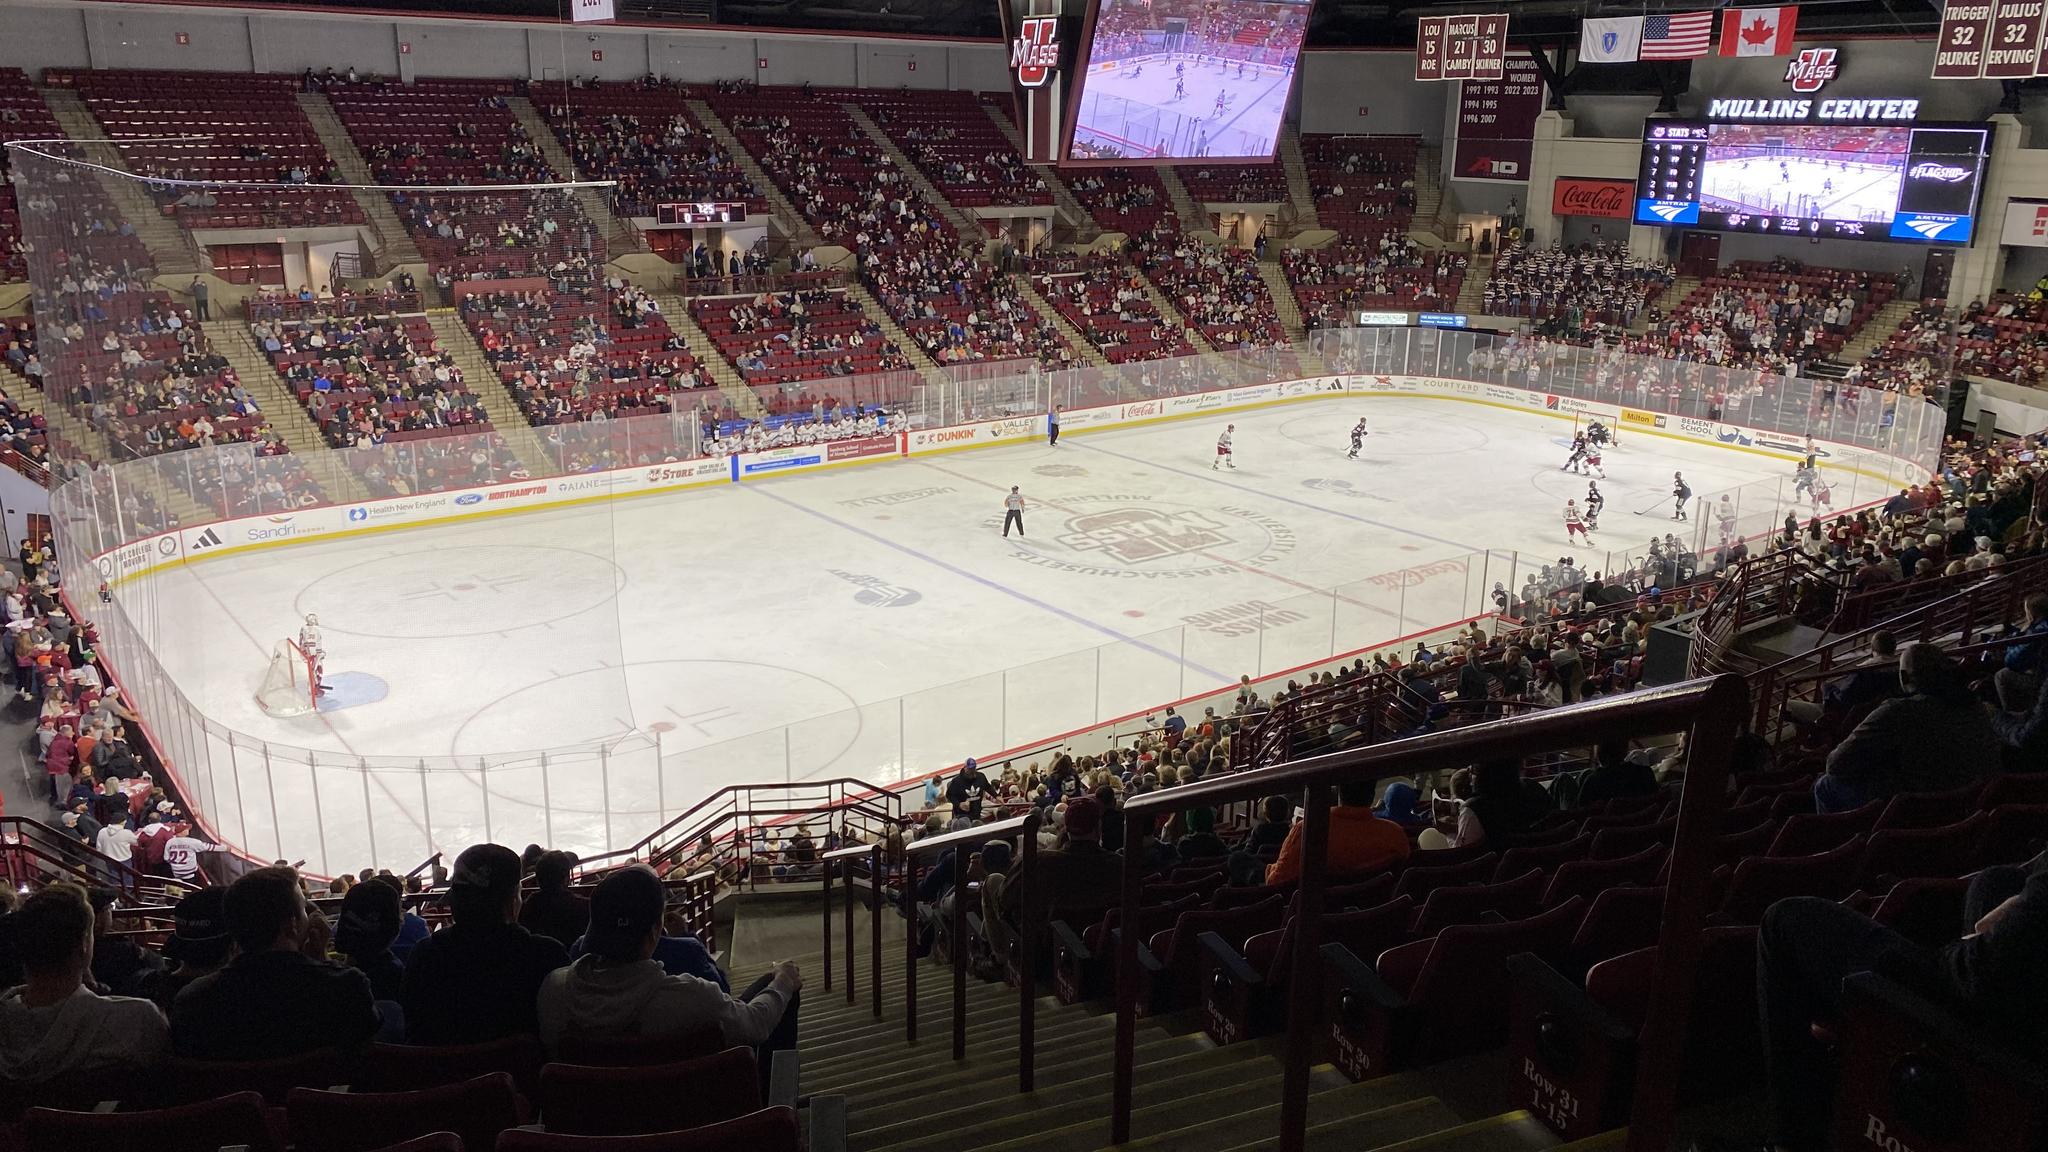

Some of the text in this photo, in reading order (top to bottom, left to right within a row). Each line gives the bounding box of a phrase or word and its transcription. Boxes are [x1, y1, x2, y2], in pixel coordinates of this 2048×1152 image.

[1946, 6, 1989, 20] TRIGGER
[1999, 3, 2041, 18] JULIUS
[1425, 25, 1440, 36] LOU
[1449, 23, 1475, 35] MARCUS
[2004, 24, 2027, 43] 32
[1952, 27, 1974, 45] 32
[1426, 41, 1435, 54] 15
[1454, 41, 1465, 54] 21
[1483, 40, 1496, 54] 30
[1938, 51, 1979, 65] BURKE
[1987, 49, 2034, 64] ERVING
[1422, 60, 1436, 70] ROE
[1447, 60, 1471, 70] CAMBY
[1476, 59, 1500, 70] SKINNER
[1510, 74, 1536, 82] WOMEN
[1466, 86, 1480, 94] 1992
[1504, 86, 1538, 94] 2022 2023
[1708, 99, 1920, 119] MULLINS CENTER
[1480, 115, 1496, 124] 2007
[1668, 128, 1690, 138] STATS
[1690, 169, 1696, 177] 7
[1562, 185, 1625, 210] Coca-Cola
[722, 212, 728, 222] 0
[1762, 218, 1769, 228] 0
[1811, 222, 1818, 232] 0
[1424, 380, 1478, 392] COURTYARD
[1128, 402, 1156, 417] Coca-Cola
[1004, 418, 1034, 428] VALLEY
[1627, 413, 1650, 423] Milton
[1682, 418, 1714, 428] BEMENT
[937, 429, 976, 442] DUNKIN'
[1681, 424, 1713, 435] SCHOOL
[662, 468, 694, 480] STORE
[489, 486, 548, 500] NORTHAMPTON
[369, 499, 446, 514] Health New England
[248, 524, 296, 540] Sandri
[1220, 505, 1296, 554] UNIVERSITY
[170, 850, 188, 864] 22
[1332, 1023, 1369, 1070] Row 30
[1524, 1056, 1578, 1119] Row 31
[1532, 1088, 1568, 1130] 1-15
[1864, 1113, 1915, 1152] Ro
